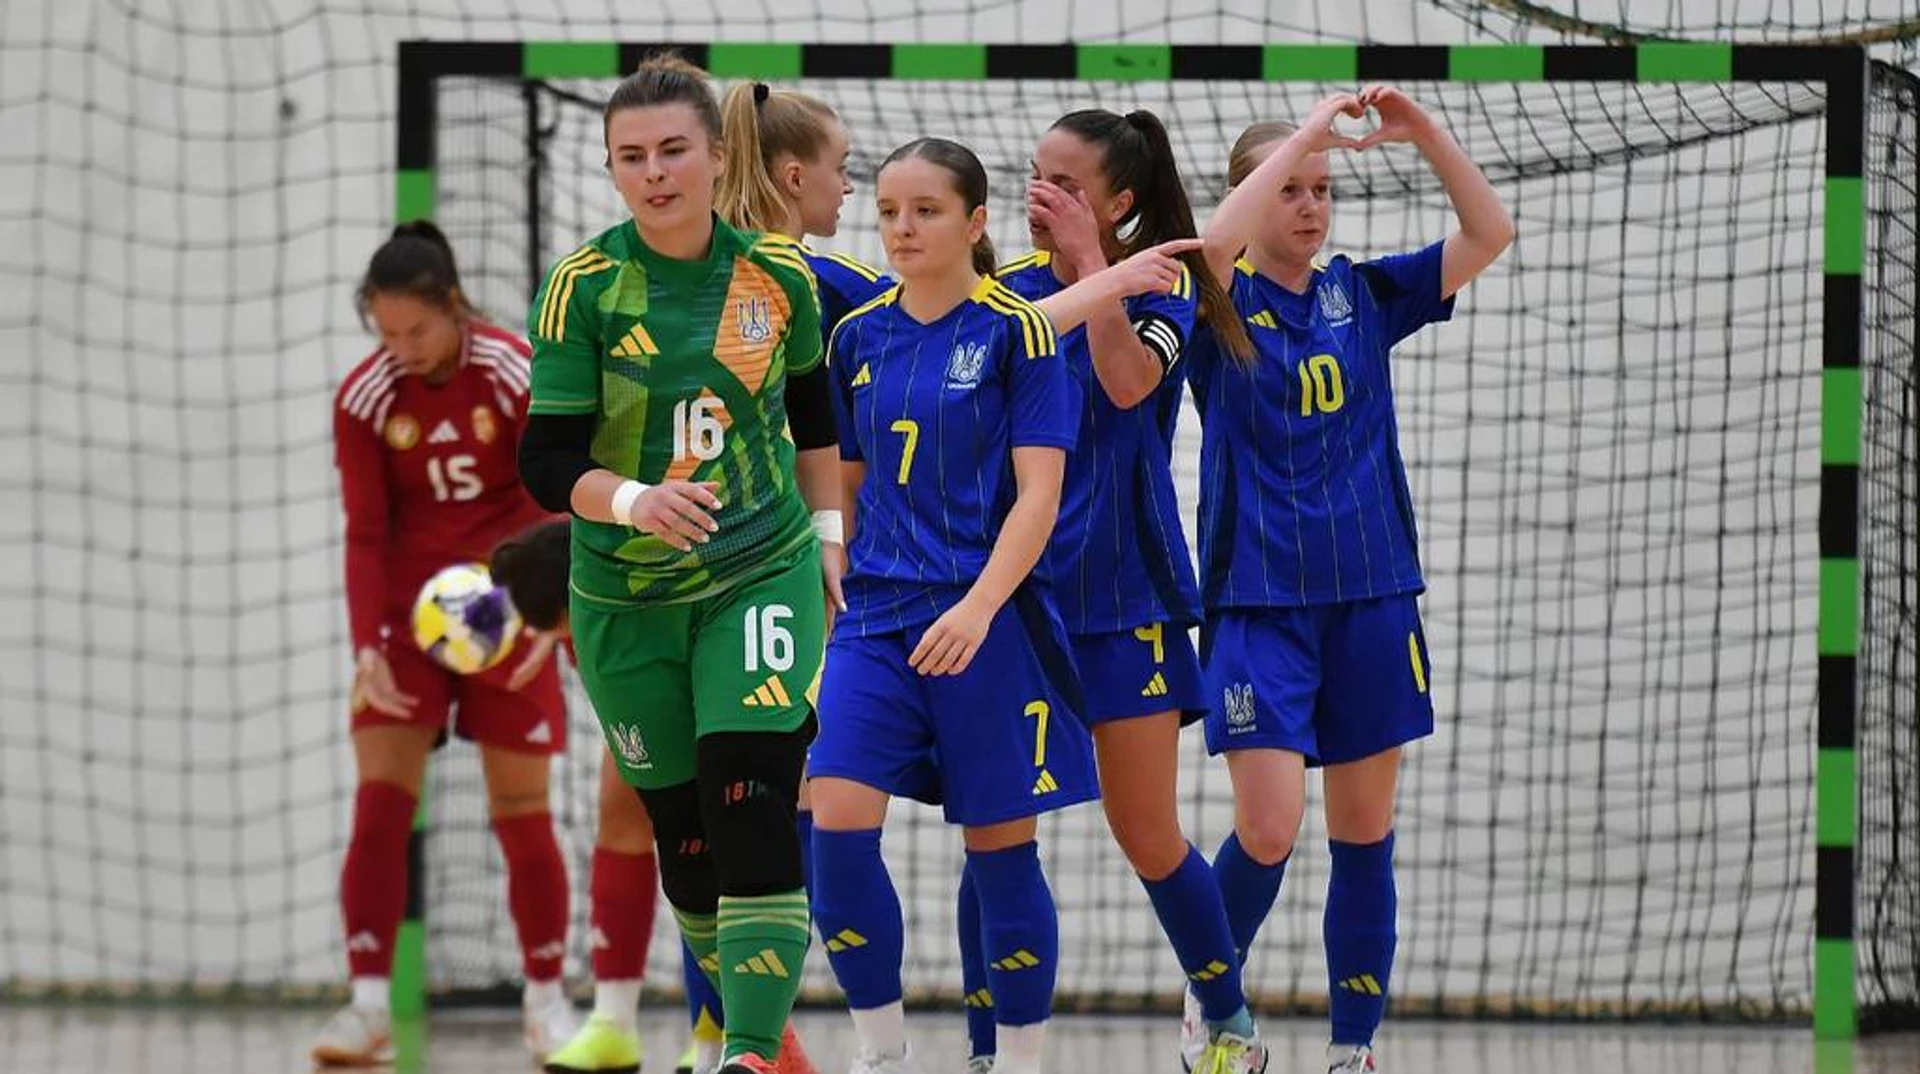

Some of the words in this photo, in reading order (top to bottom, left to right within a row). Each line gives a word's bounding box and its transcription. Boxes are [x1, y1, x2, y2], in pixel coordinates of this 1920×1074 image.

[1298, 354, 1344, 417] 10
[673, 397, 725, 461] 16
[890, 420, 919, 485] 7
[427, 454, 484, 501] 15
[744, 604, 795, 672] 16
[1024, 700, 1049, 767] 7
